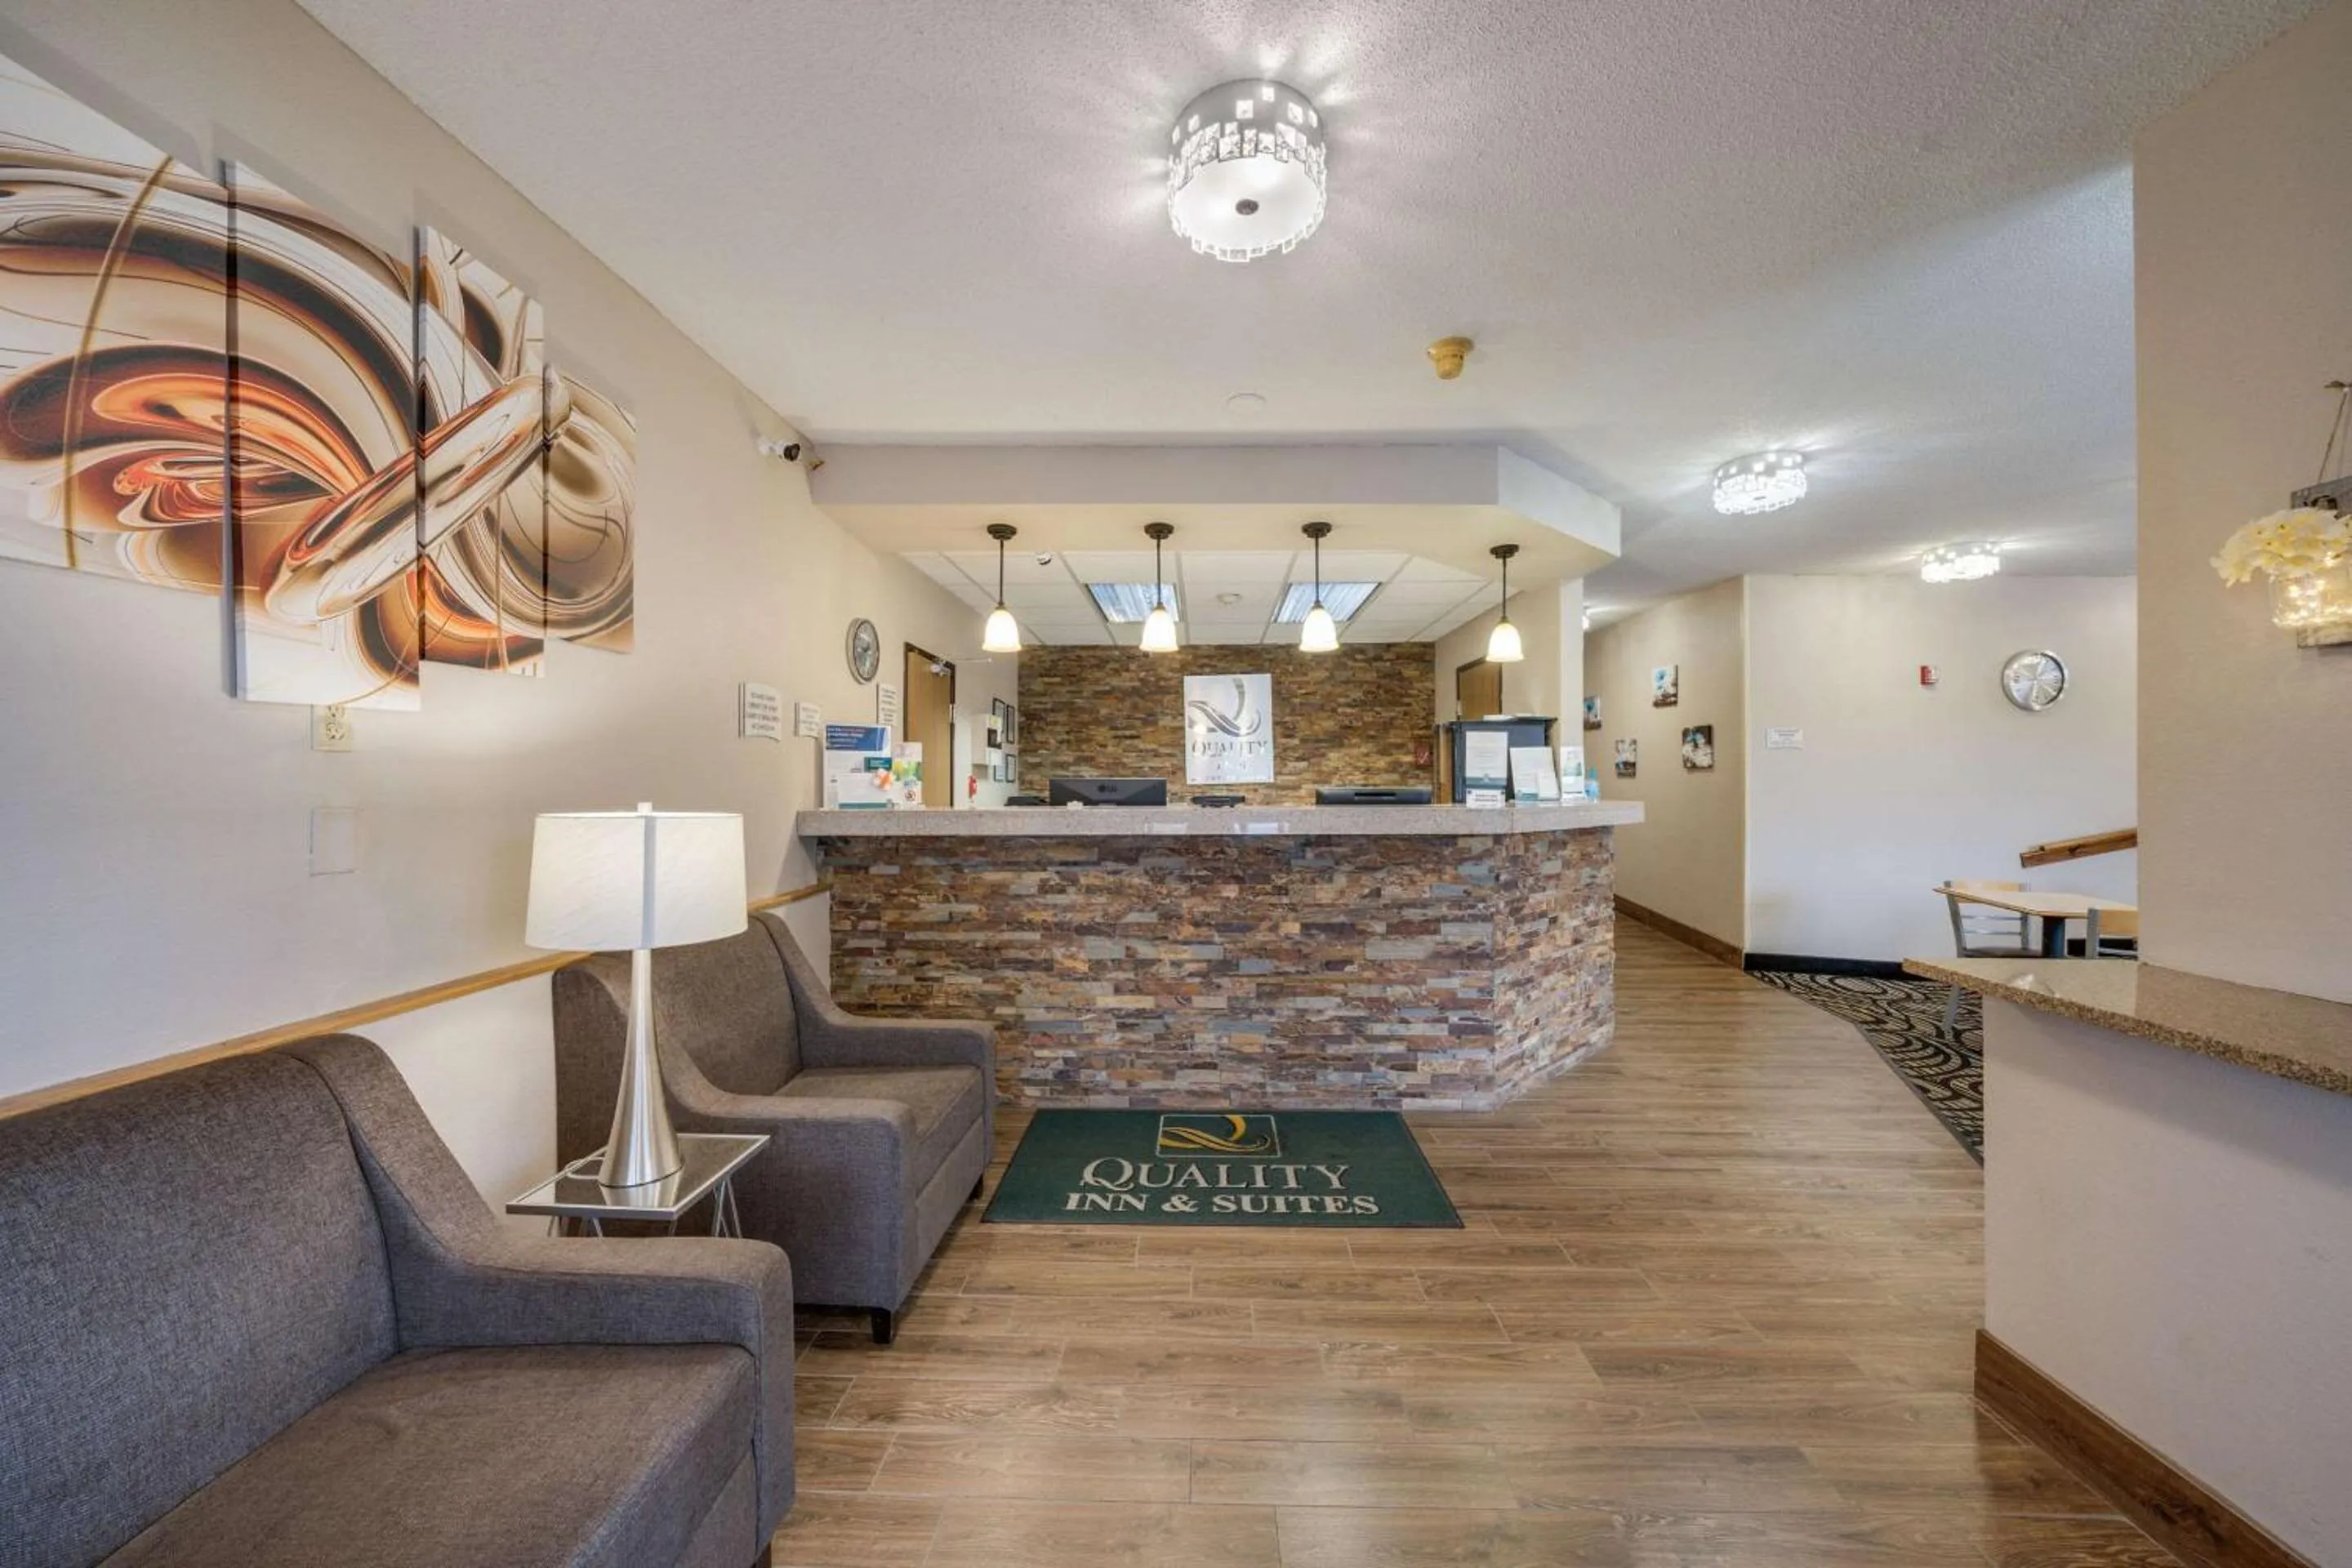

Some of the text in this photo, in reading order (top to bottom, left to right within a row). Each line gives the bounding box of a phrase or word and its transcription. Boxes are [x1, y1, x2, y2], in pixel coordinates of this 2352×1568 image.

[1079, 1157, 1351, 1191] QUALITY
[1064, 1192, 1380, 1215] INN & SUITES
